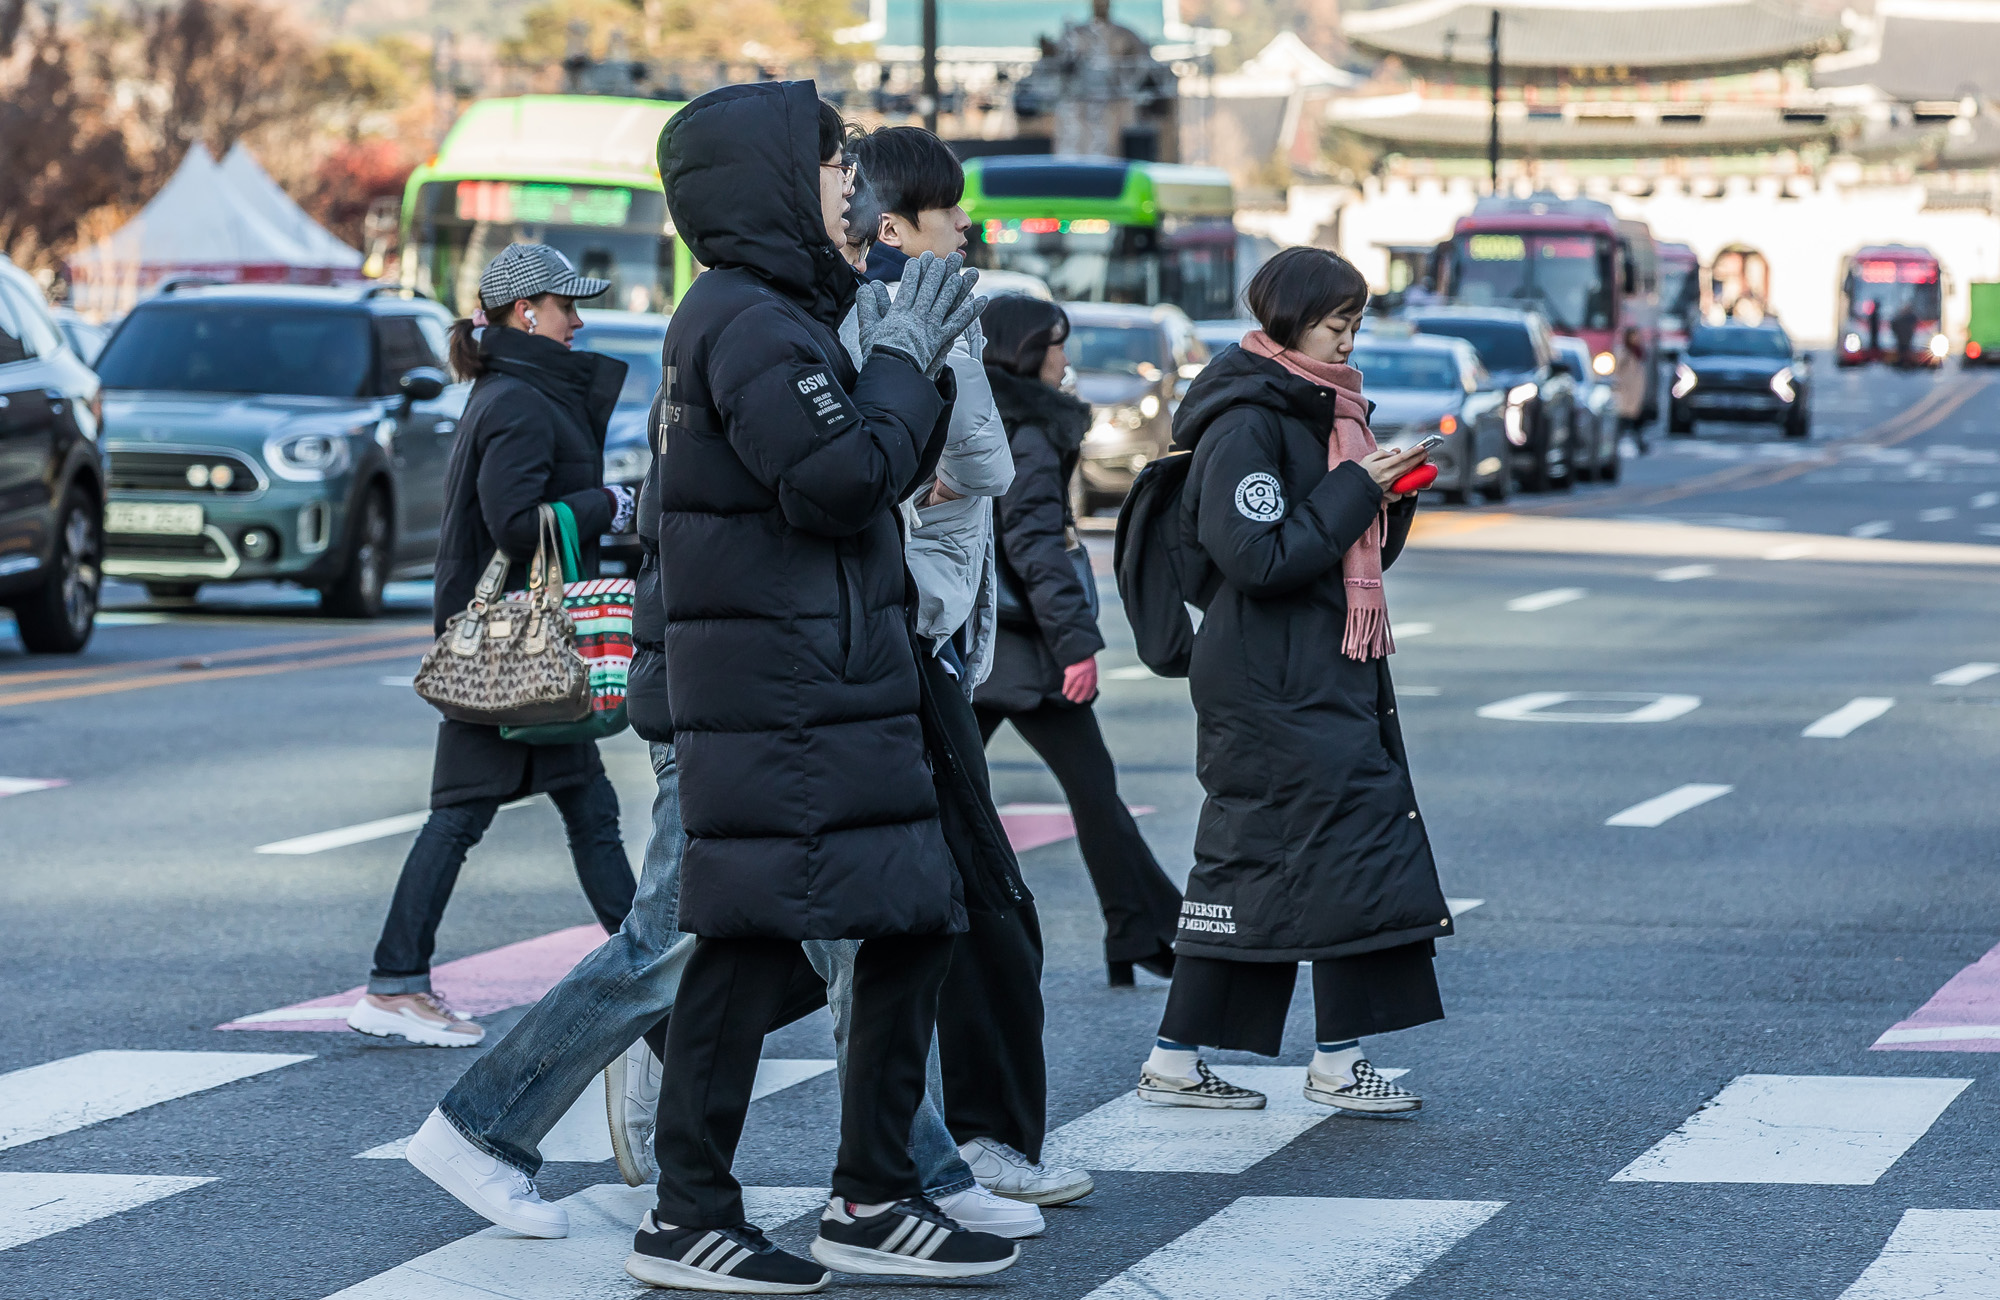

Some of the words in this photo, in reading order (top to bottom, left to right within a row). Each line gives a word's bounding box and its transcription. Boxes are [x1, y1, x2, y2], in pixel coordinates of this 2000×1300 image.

[797, 372, 829, 394] GSW
[812, 391, 832, 404] GOLDEN
[818, 398, 833, 409] STATE
[816, 402, 842, 417] WARRIORS
[1185, 918, 1236, 934] MEDICINE
